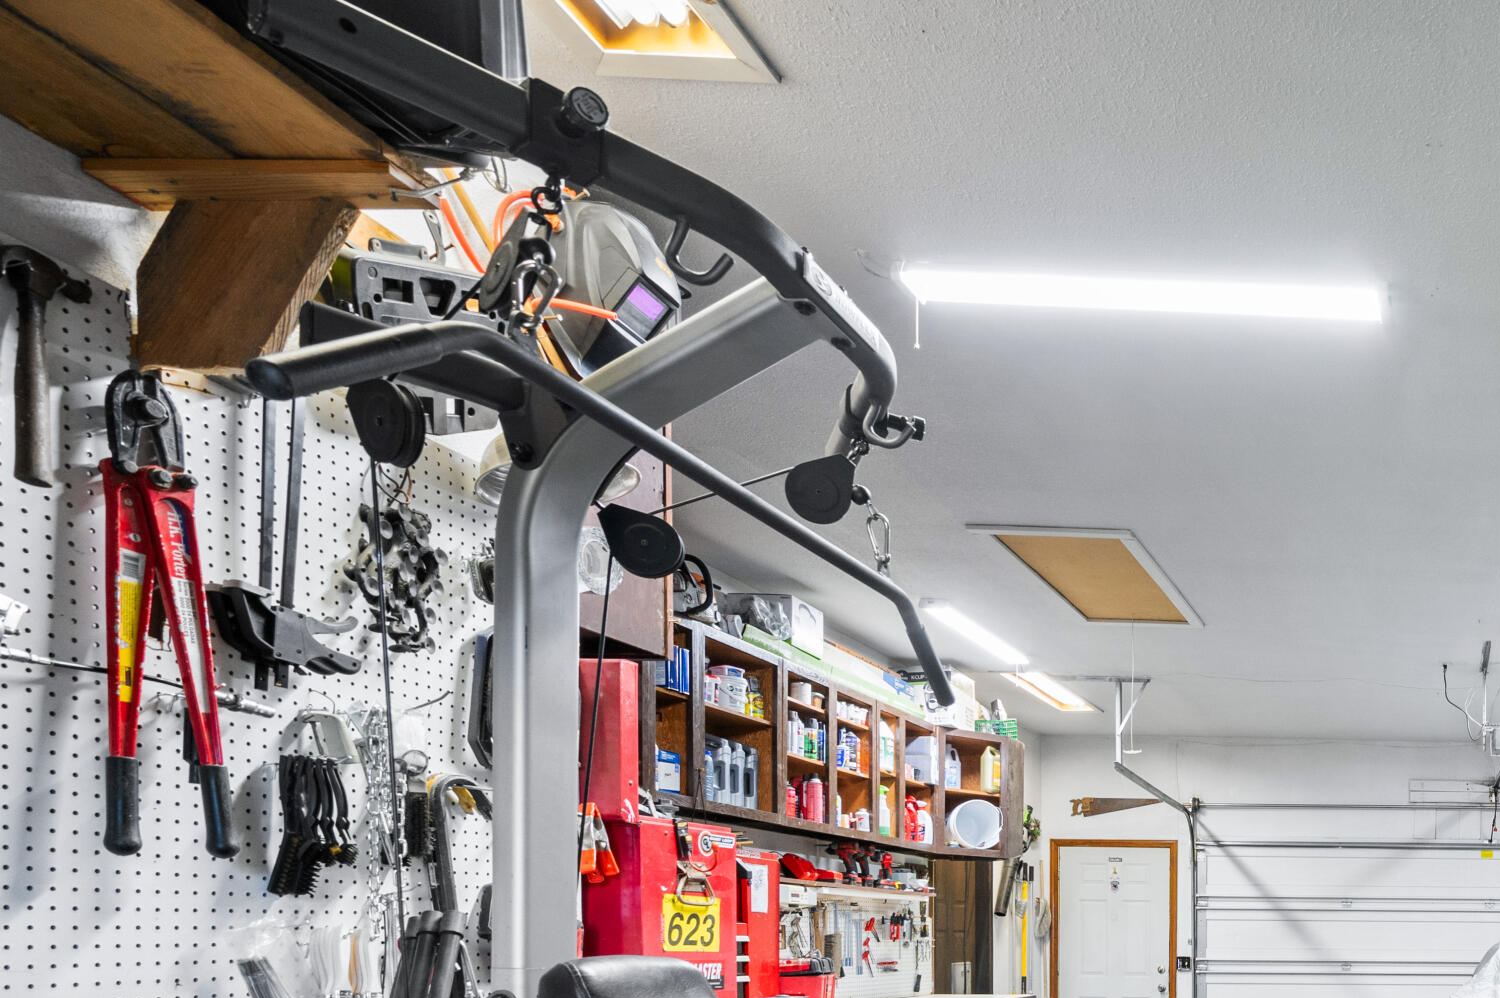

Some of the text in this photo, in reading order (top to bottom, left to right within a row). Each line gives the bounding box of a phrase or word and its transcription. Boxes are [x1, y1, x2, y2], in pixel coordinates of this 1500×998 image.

[167, 511, 184, 538] H.K.
[171, 541, 188, 580] Porter
[667, 912, 716, 947] 623
